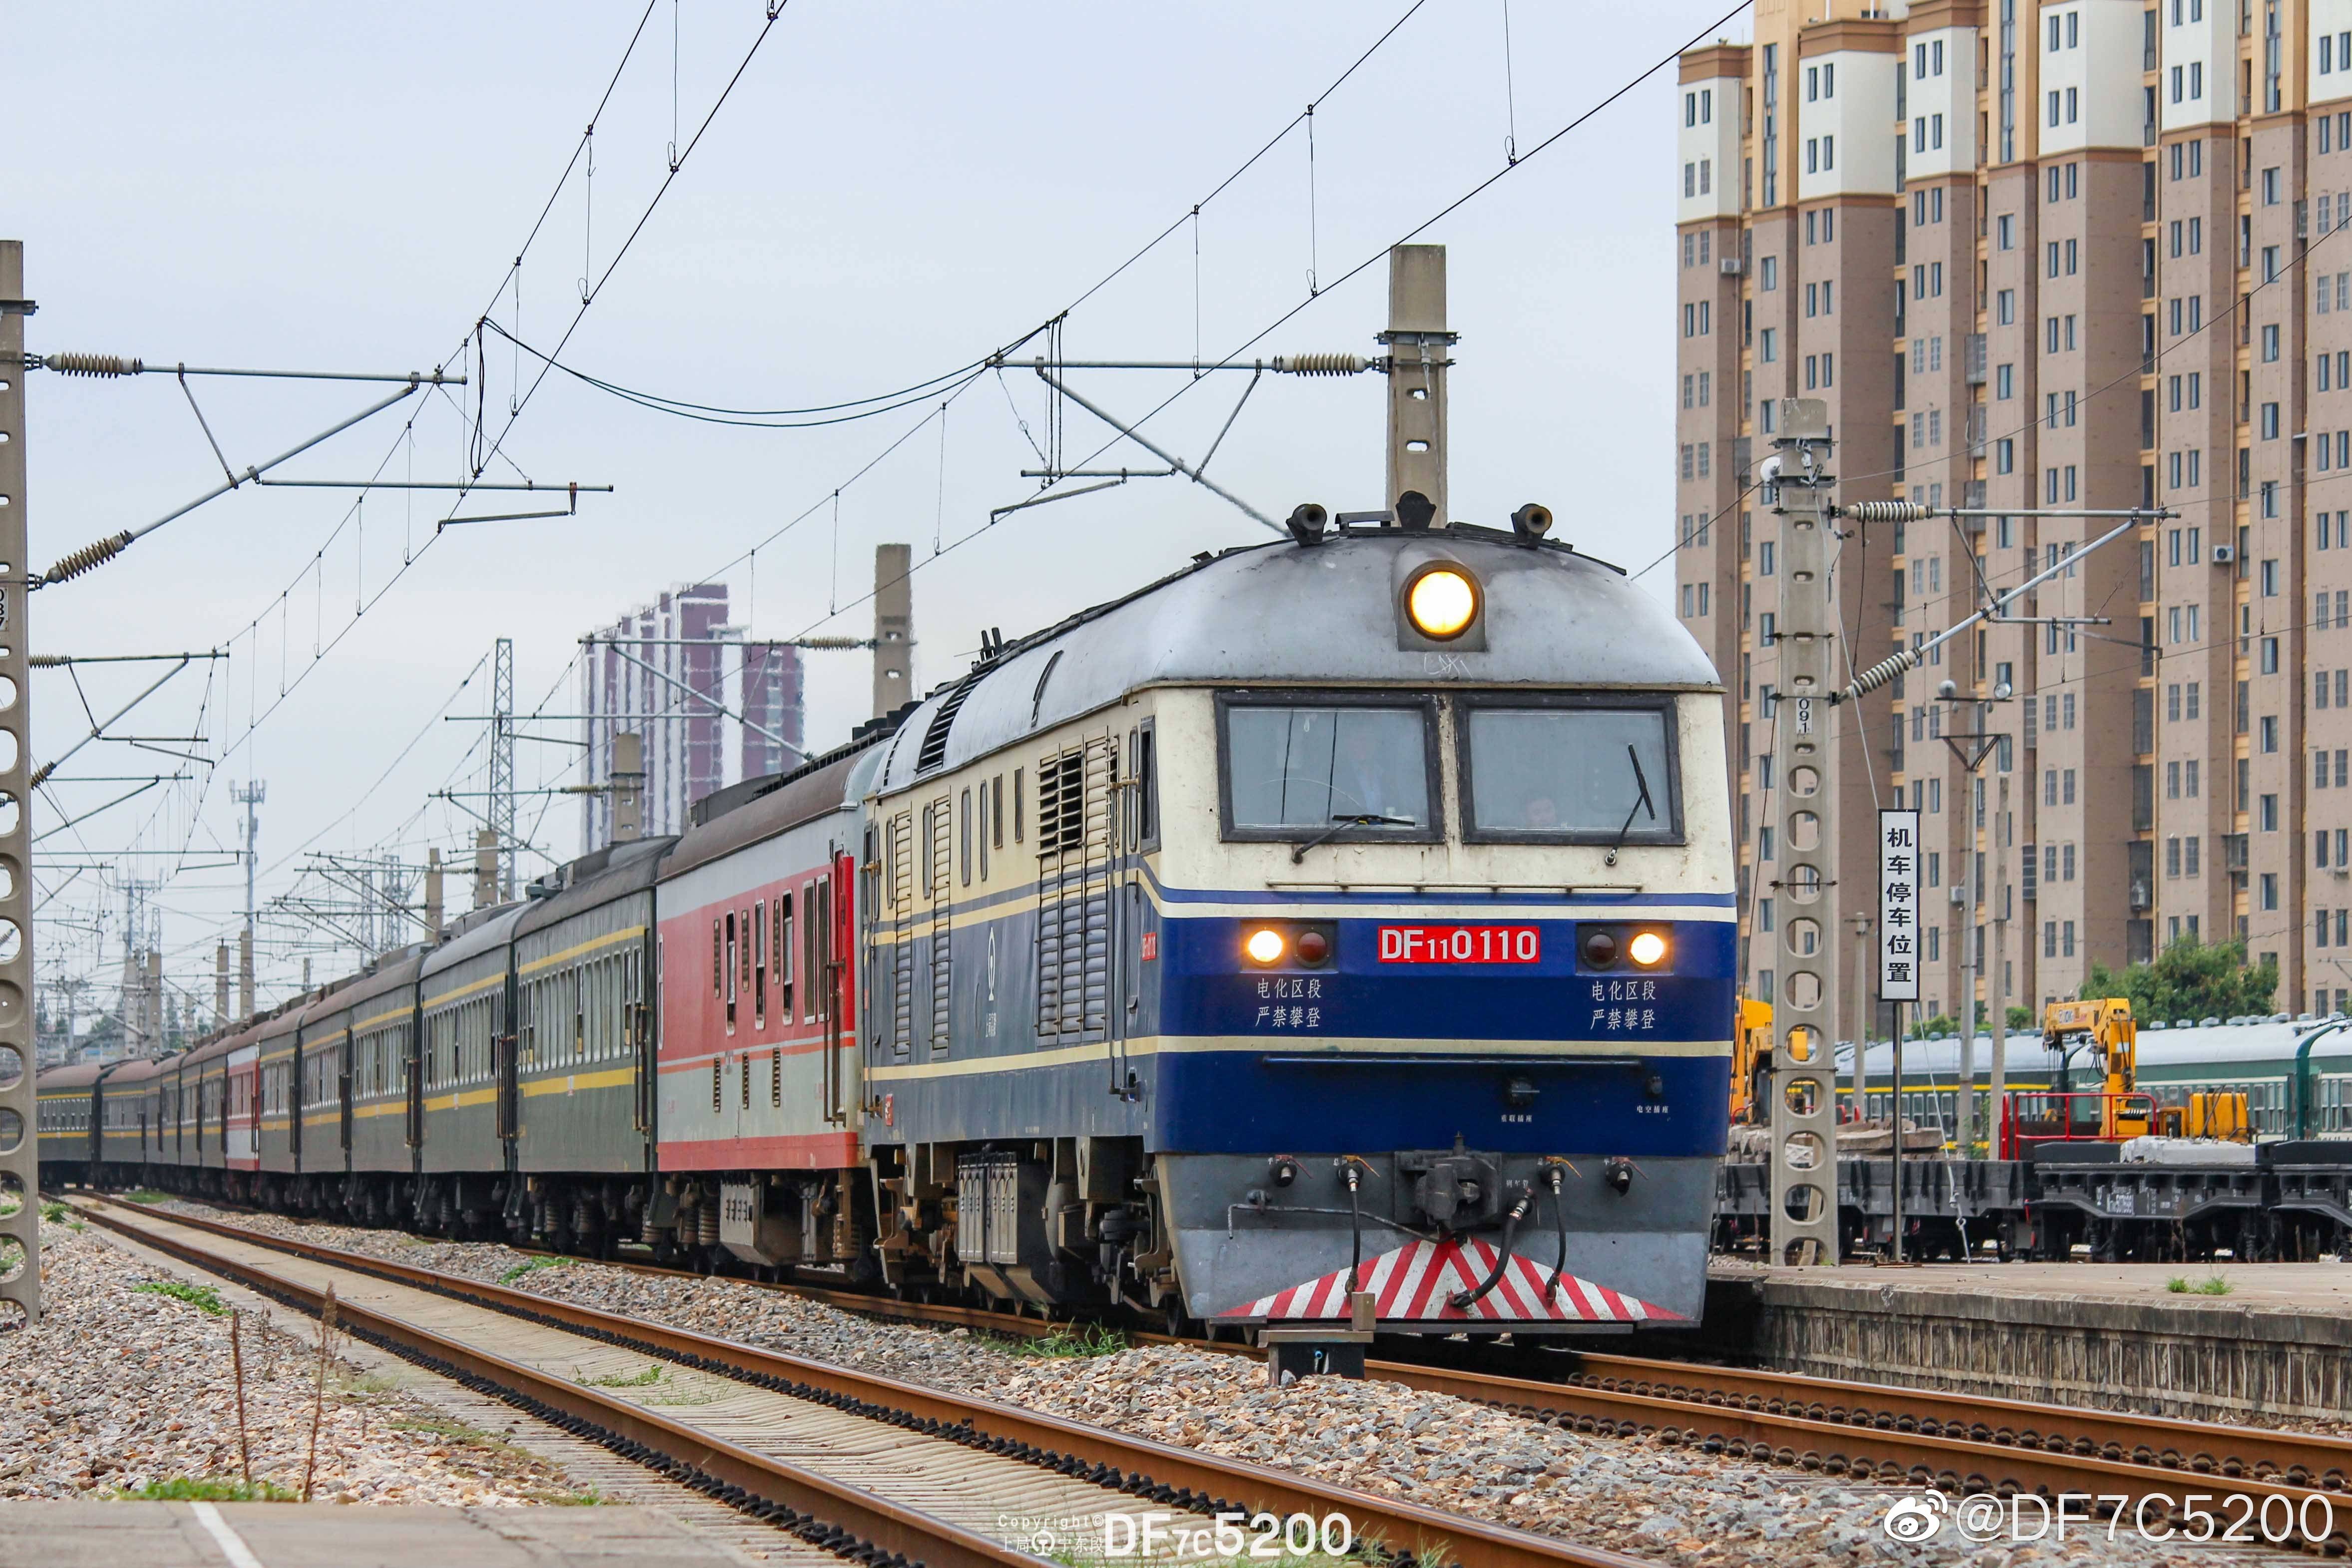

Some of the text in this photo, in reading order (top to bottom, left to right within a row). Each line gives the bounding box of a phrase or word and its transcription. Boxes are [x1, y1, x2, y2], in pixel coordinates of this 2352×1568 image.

[1799, 698, 1809, 733] 091
[1886, 828, 1912, 982] 机车停车位置
[1258, 977, 1322, 999] 电化区段
[1592, 980, 1656, 1001] 电化区段
[1255, 1006, 1321, 1028] 严禁攀登
[1590, 1008, 1655, 1030] 严禁攀登
